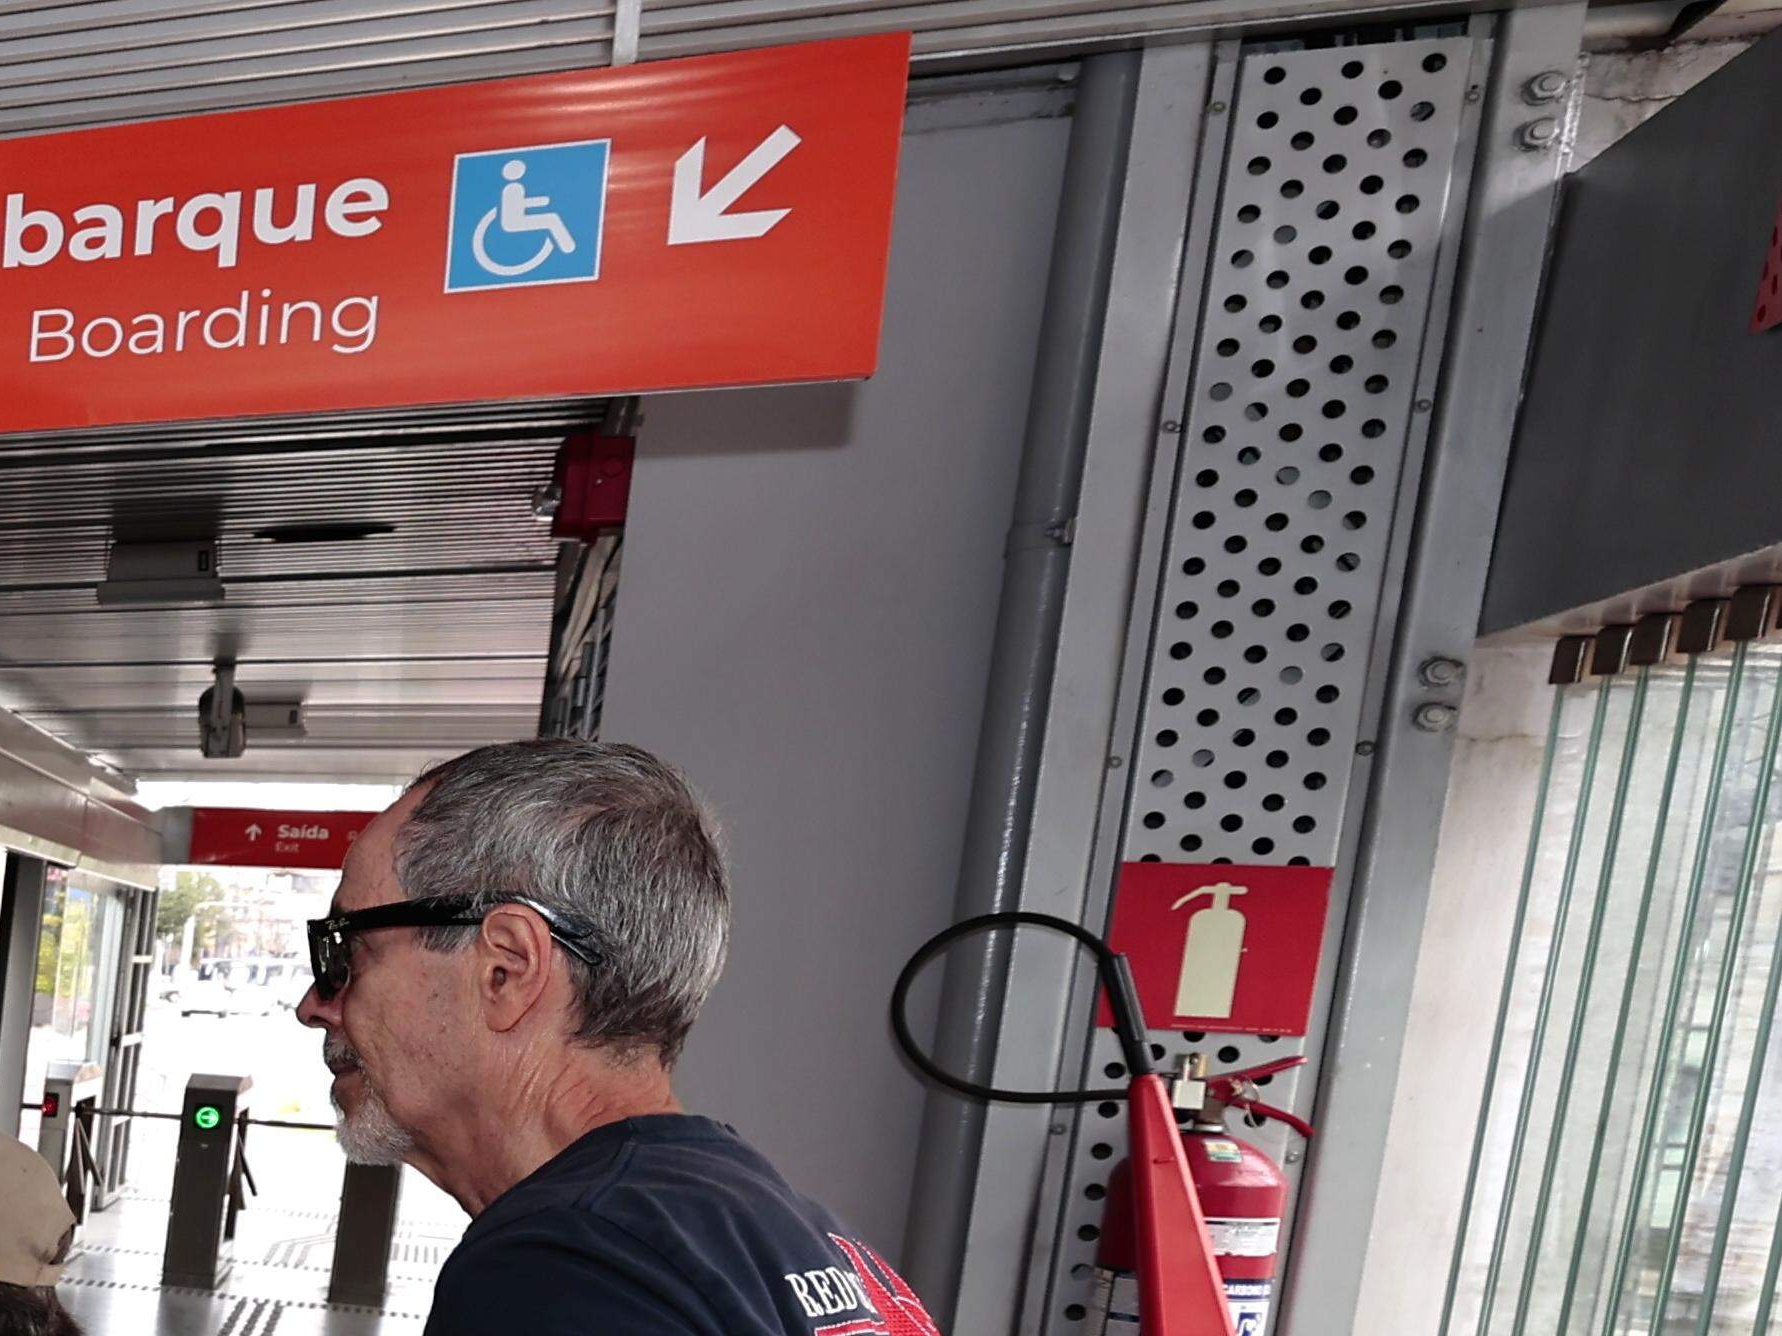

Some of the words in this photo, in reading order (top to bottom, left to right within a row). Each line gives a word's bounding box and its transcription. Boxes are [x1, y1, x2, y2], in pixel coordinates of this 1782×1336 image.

[28, 287, 379, 362] Boarding
[277, 824, 330, 840] Saída
[275, 841, 300, 853] Exit
